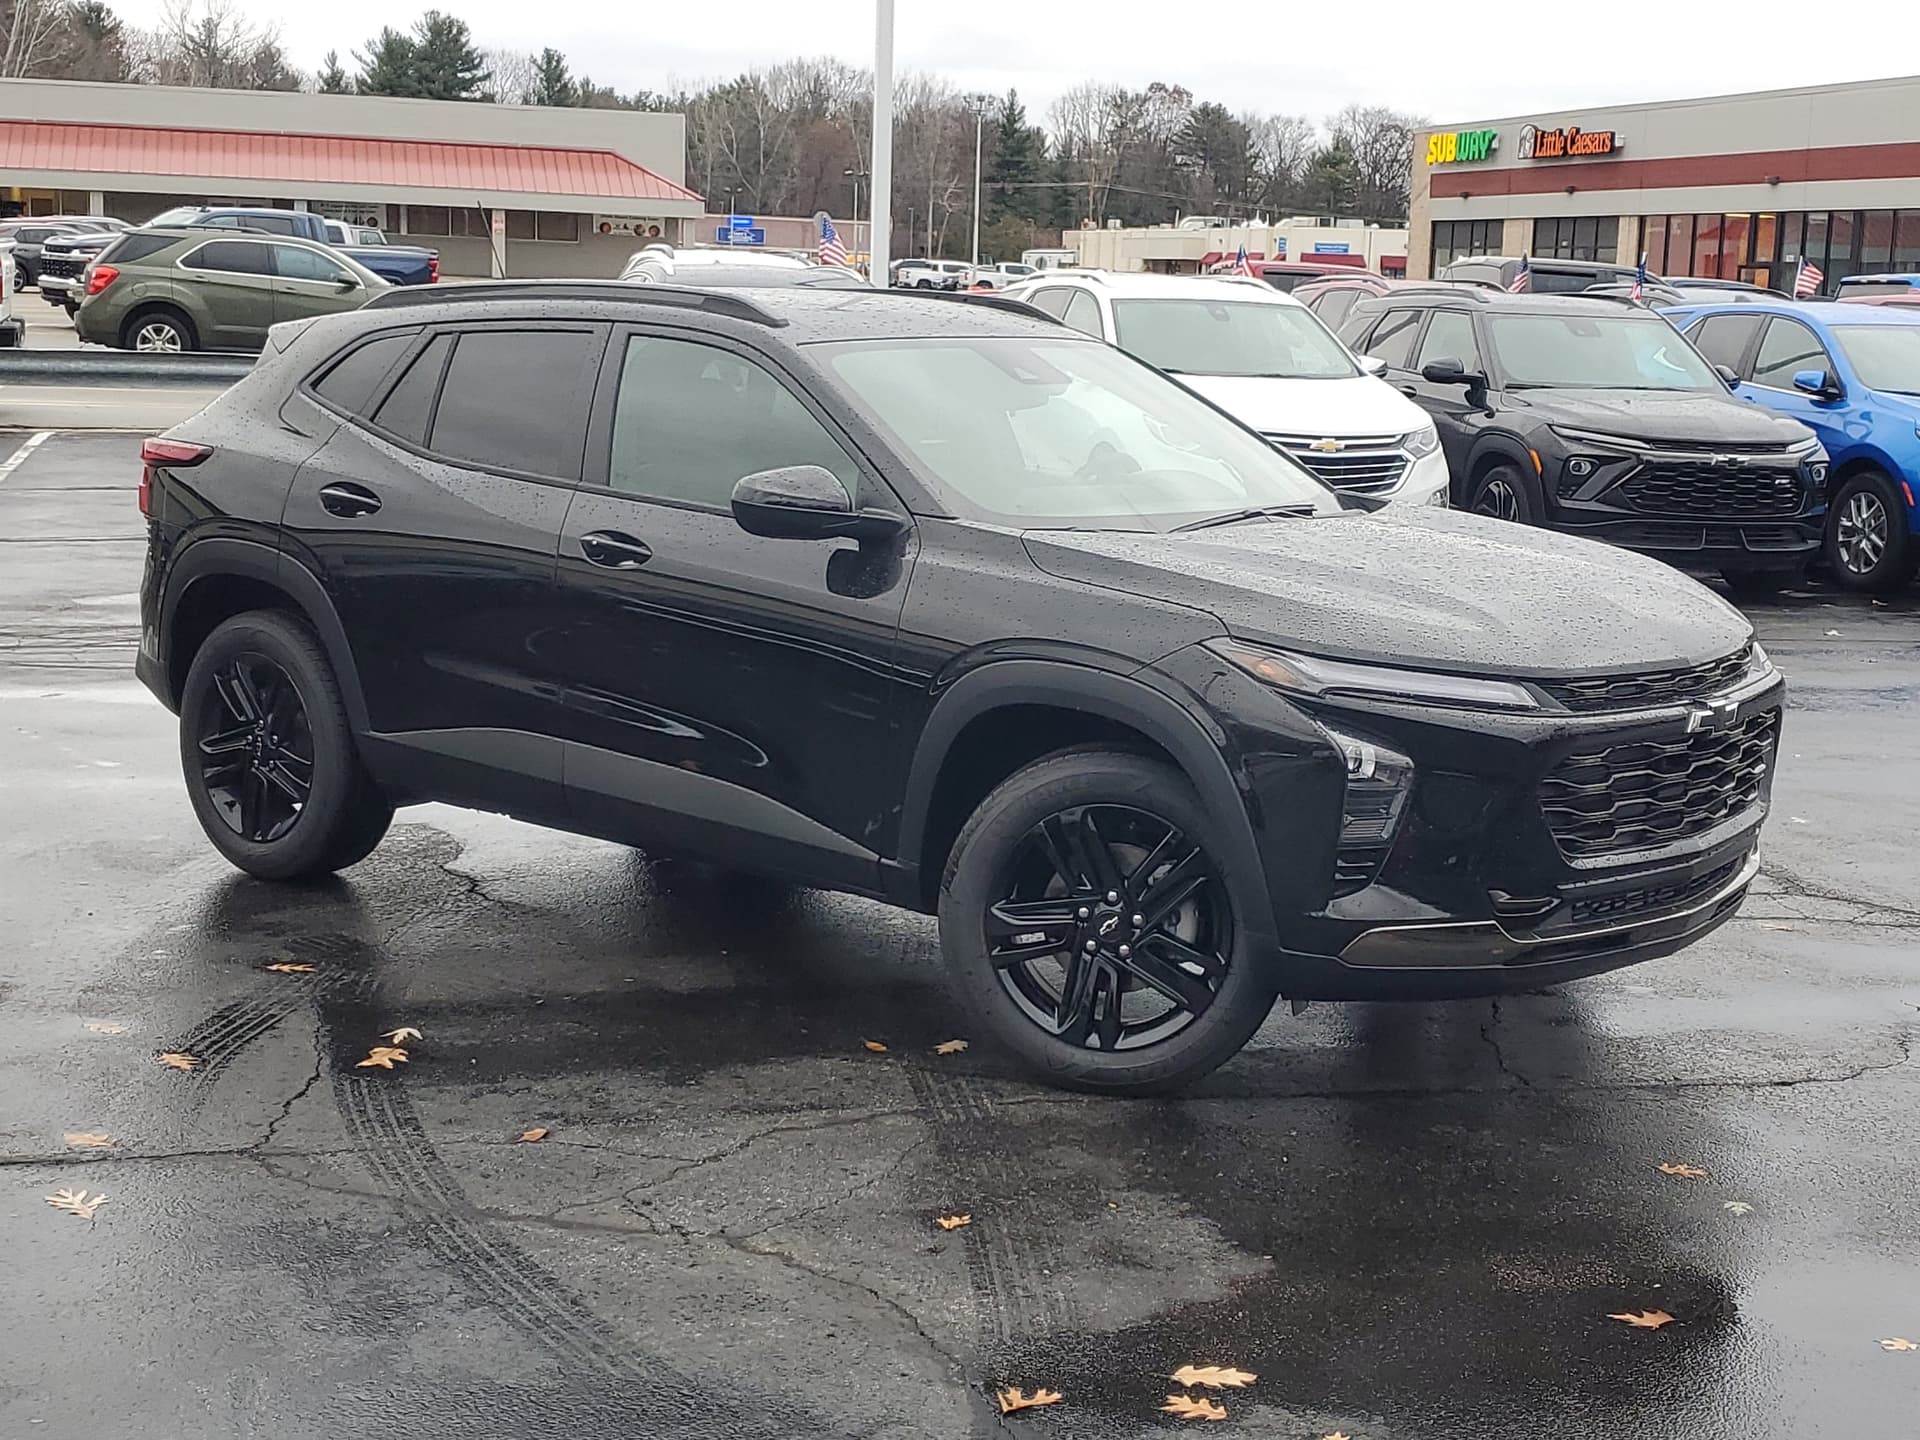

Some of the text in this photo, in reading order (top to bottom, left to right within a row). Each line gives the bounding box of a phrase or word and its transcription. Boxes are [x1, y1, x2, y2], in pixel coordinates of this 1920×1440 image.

[1426, 128, 1497, 165] SUBWAY
[1535, 127, 1612, 157] Little Caesars
